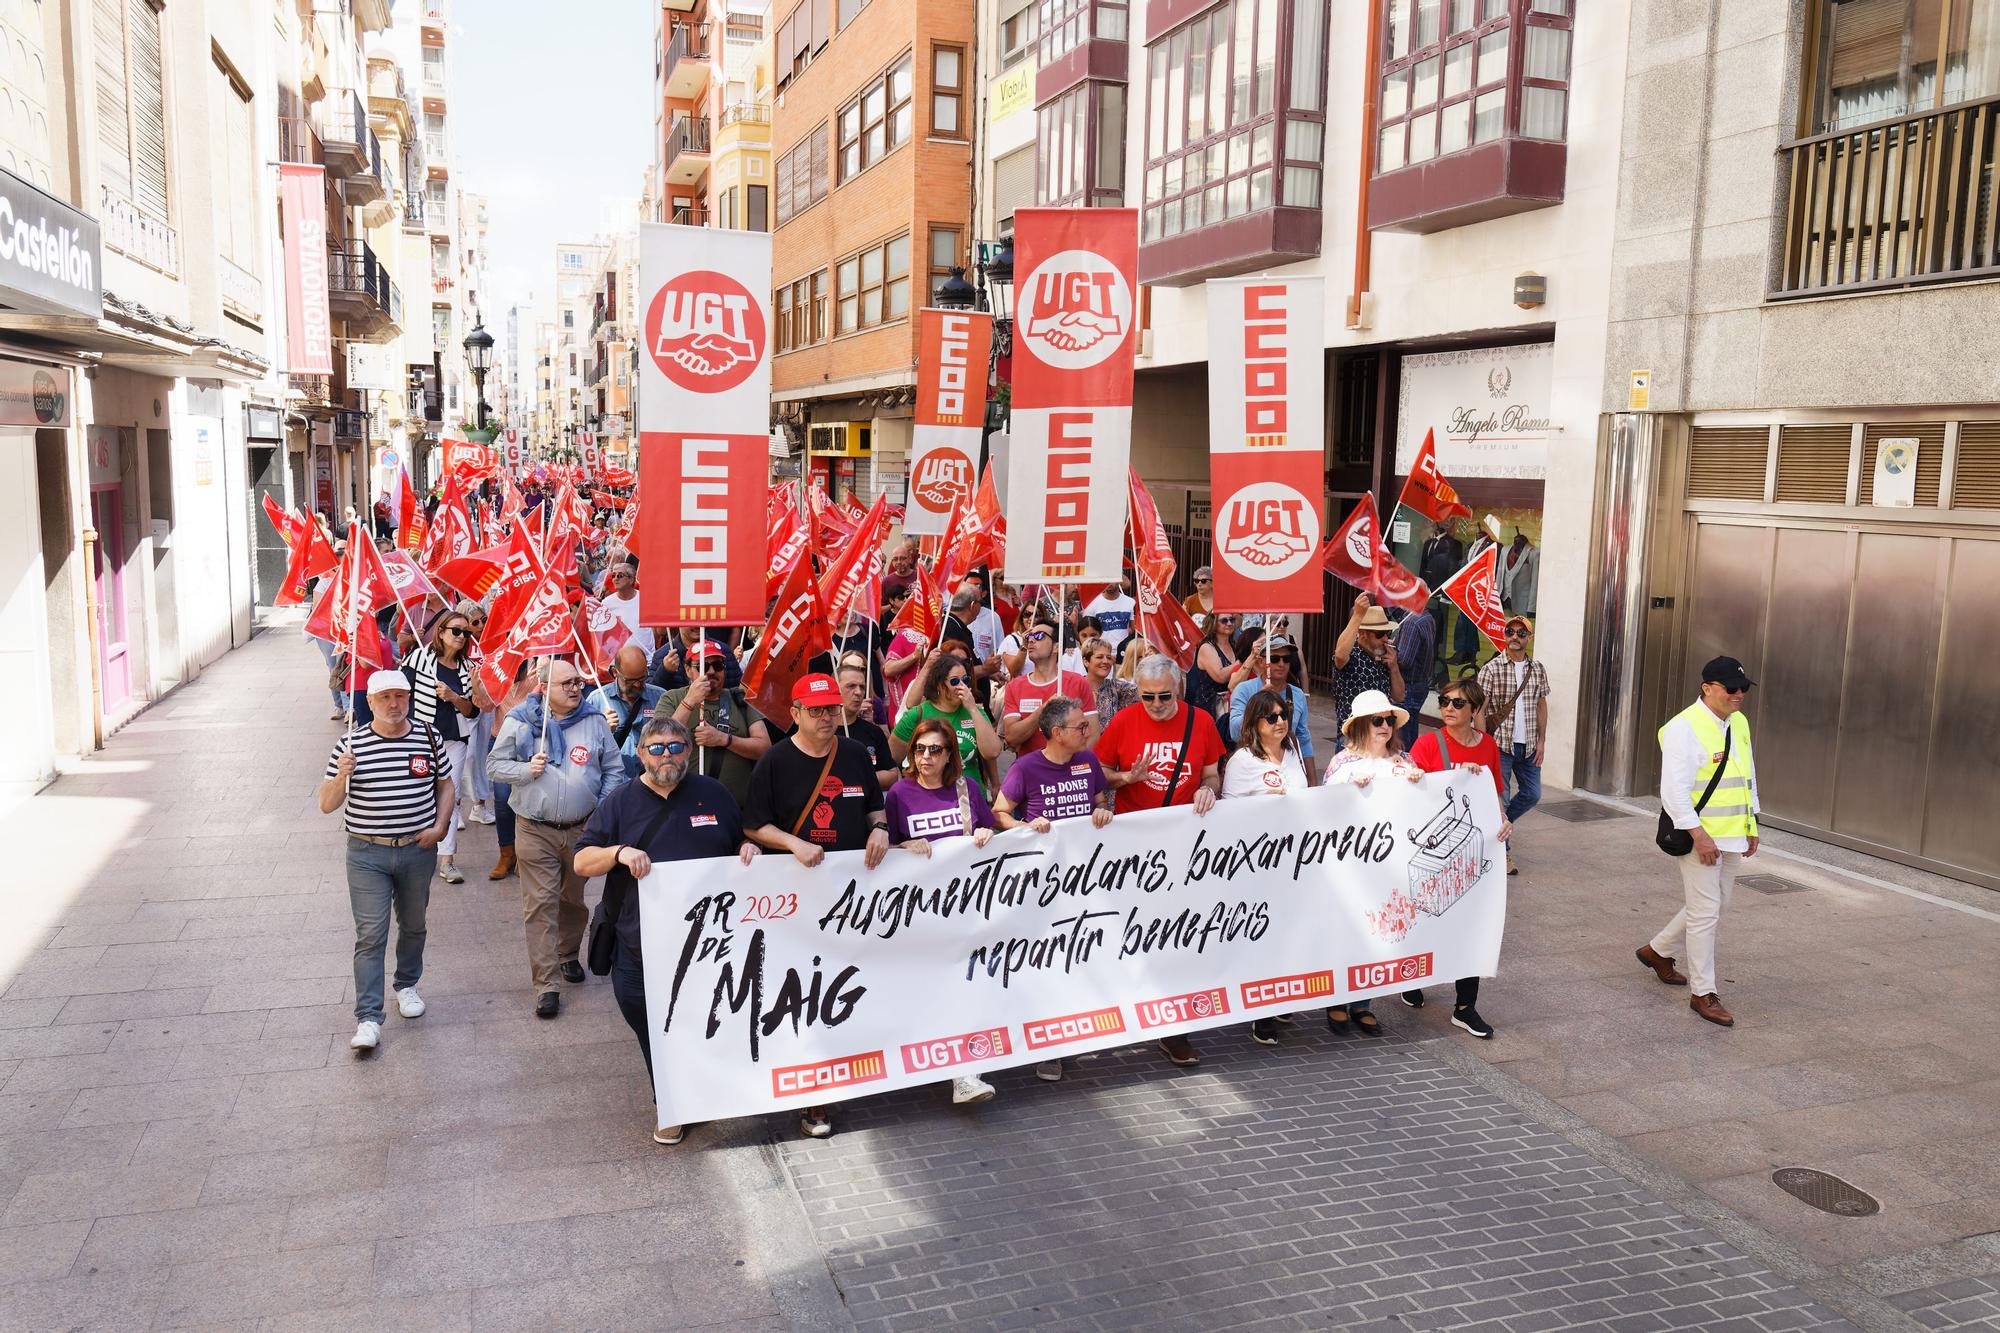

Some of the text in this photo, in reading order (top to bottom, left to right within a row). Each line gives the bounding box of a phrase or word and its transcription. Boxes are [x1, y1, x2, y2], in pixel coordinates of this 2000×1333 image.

[0, 196, 93, 291] Castellón
[300, 219, 327, 357] PRONOVIAS
[1032, 272, 1115, 319] UGT
[661, 290, 749, 341] UGT
[937, 315, 970, 415] CCOO
[1244, 285, 1287, 433] CCOO
[1446, 406, 1499, 444] Angelo
[506, 429, 519, 479] UGT
[583, 433, 597, 477] UGT
[920, 458, 967, 483] UGT
[1042, 413, 1094, 563] CCOO
[680, 439, 729, 605] CCOO
[1228, 500, 1303, 538] UGT
[1040, 779, 1088, 795] Les DONES
[1045, 793, 1089, 806] es mouen
[1057, 803, 1091, 816] CCOO
[819, 822, 1395, 939] Augmentar salaris, baixar preus
[741, 893, 798, 923] 2023
[664, 891, 736, 1036] 1R
[697, 935, 734, 962] DE
[965, 901, 1270, 988] repartir beneficis
[1246, 980, 1305, 1003] CCOO
[1355, 963, 1398, 988] UGT
[1029, 1017, 1094, 1044] CCOO
[1143, 998, 1188, 1026] UGT
[911, 1039, 964, 1069] UGT
[778, 1062, 851, 1091] CCOO
